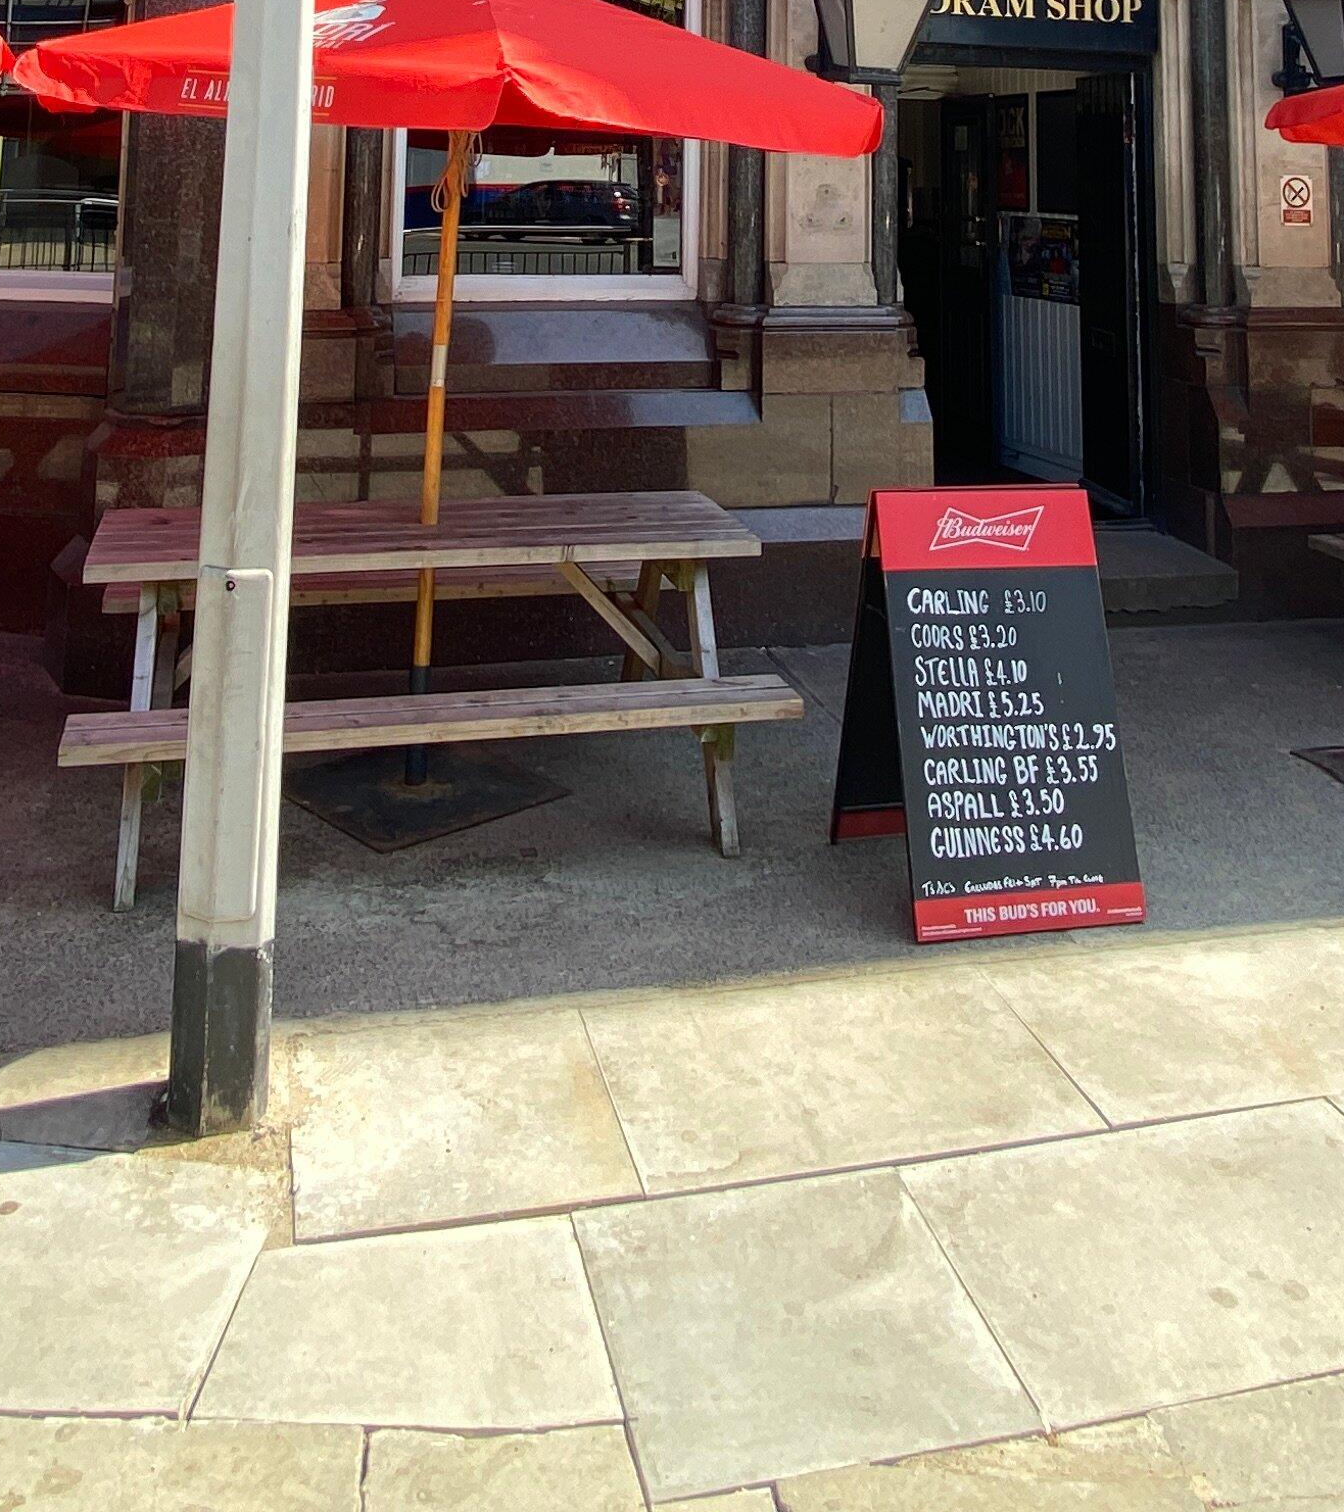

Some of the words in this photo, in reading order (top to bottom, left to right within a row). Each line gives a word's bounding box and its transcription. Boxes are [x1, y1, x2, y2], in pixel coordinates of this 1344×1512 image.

[181, 77, 198, 99] EL
[204, 79, 230, 102] AL
[937, 517, 1033, 538] Budweiser
[907, 588, 990, 615] CARLING
[1004, 589, 1047, 614] £3.10
[911, 623, 964, 651] COORS
[968, 624, 1017, 650] £3.20
[915, 655, 980, 687] STELLA
[984, 657, 1028, 686] £4.10
[918, 690, 984, 719] MADRI
[988, 691, 1045, 719] £5.25
[920, 723, 1060, 751] WORTHINGTON'S
[1061, 722, 1116, 751] £2.95
[923, 755, 1007, 786] CARLING
[1012, 754, 1039, 785] BF
[1045, 754, 1098, 785] £3.55
[927, 790, 1005, 822] ASPALL
[1008, 787, 1065, 819] £3.50
[930, 825, 1026, 859] GUINNESS
[1029, 823, 1083, 852] £4.60
[963, 906, 996, 924] THIS
[999, 902, 1039, 921] BUD'S
[1040, 900, 1068, 917] FOR
[1068, 897, 1101, 914] YOU.
